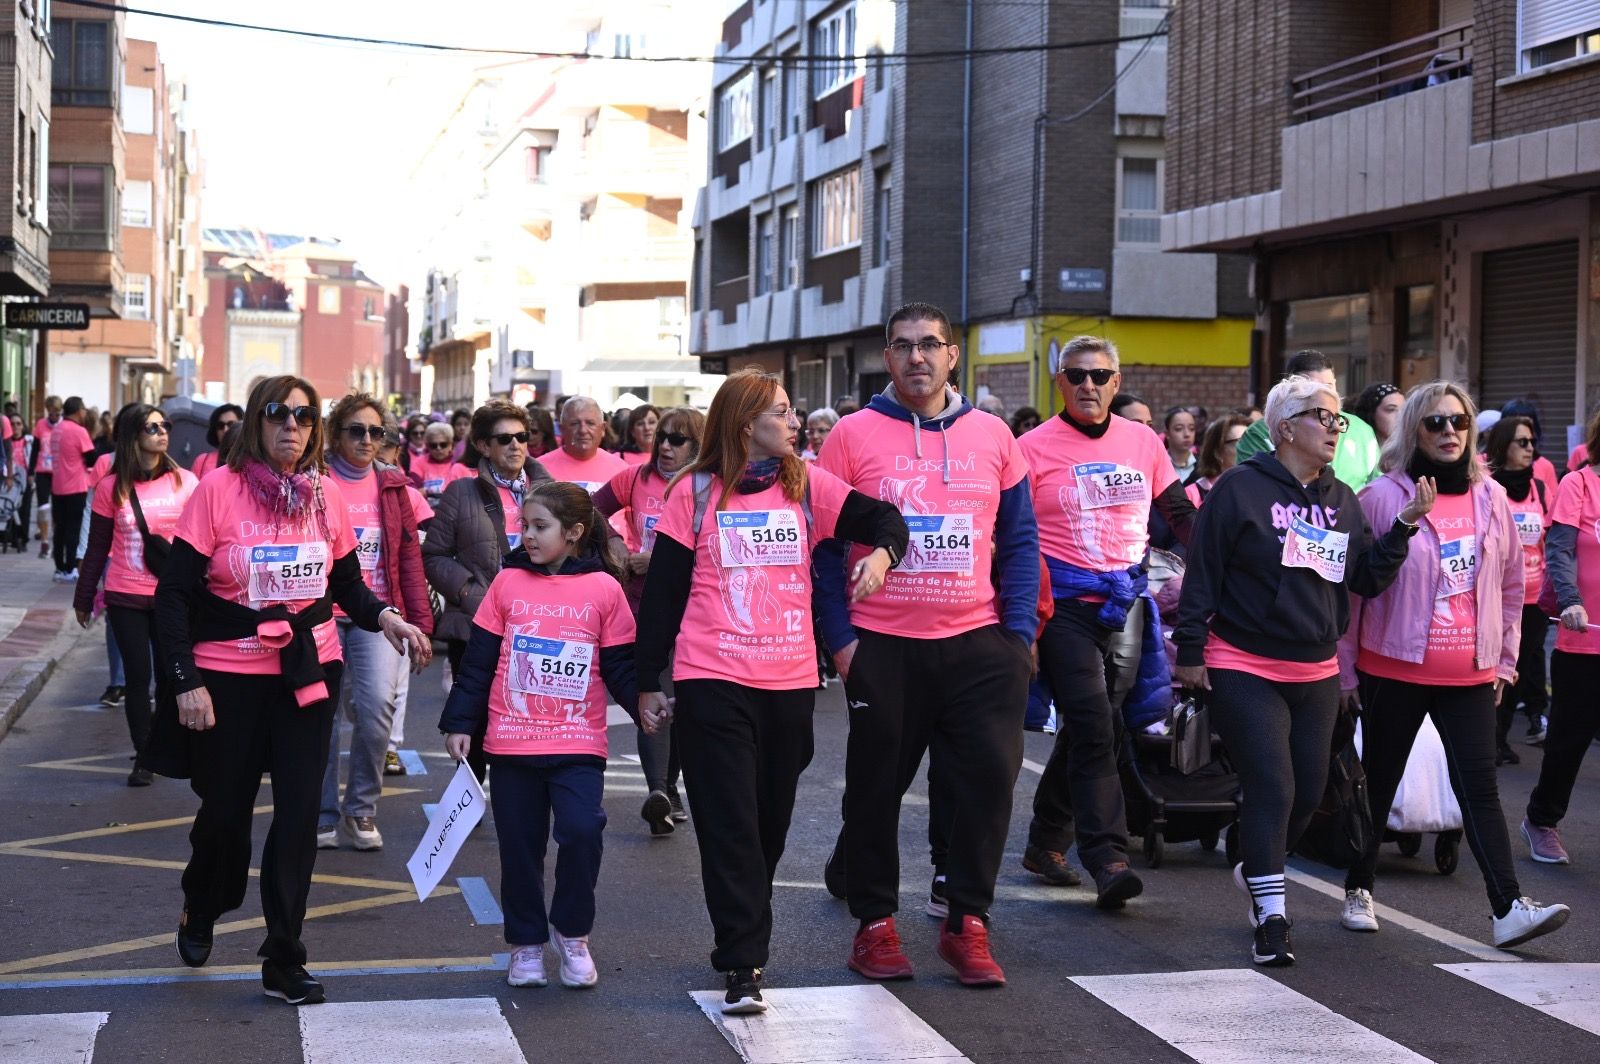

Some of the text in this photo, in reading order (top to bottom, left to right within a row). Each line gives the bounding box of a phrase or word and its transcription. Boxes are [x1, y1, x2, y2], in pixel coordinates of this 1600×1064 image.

[11, 310, 85, 323] CARNICERIA
[1103, 473, 1143, 487] 1234
[752, 528, 798, 543] 5165
[924, 534, 970, 549] 5164
[1307, 542, 1345, 564] 2216
[281, 562, 324, 578] 5157
[886, 575, 924, 584] Carrera
[927, 577, 940, 585] de
[943, 579, 952, 587] la
[886, 585, 912, 593] almom
[720, 632, 805, 643] Carrera de la Mujer
[719, 643, 747, 651] almom
[540, 658, 588, 678] 5167
[558, 676, 584, 685] Carrera
[498, 723, 524, 731] almom
